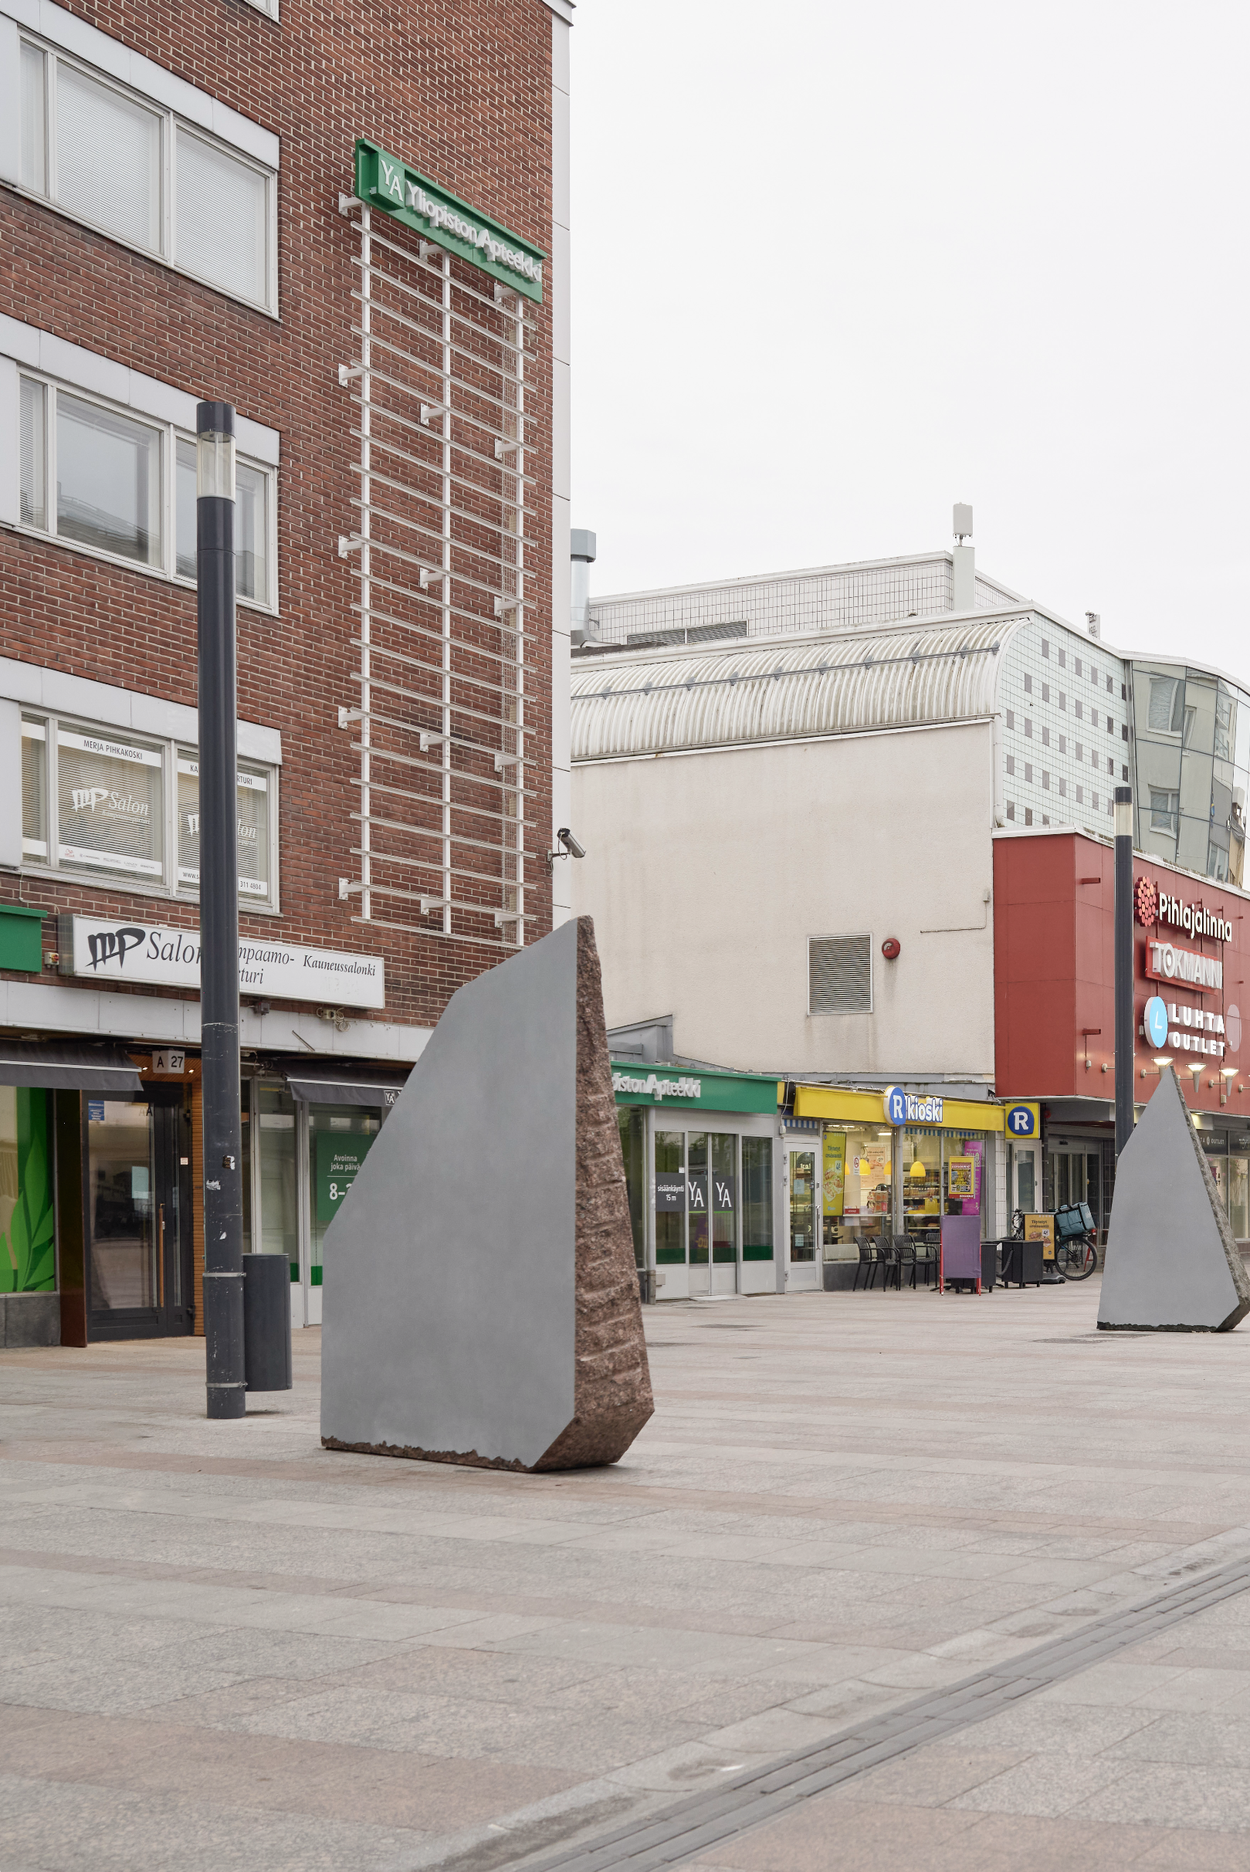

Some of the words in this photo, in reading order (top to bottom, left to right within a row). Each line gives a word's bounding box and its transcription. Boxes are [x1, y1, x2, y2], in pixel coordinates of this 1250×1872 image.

[380, 159, 404, 202] YA
[405, 179, 477, 244] Yliopiston
[475, 229, 542, 283] Apteekki
[84, 740, 104, 751] MERJA
[106, 744, 143, 760] PIHKAKOSKI
[237, 774, 253, 785] RTURI
[108, 792, 148, 815] Salon
[237, 818, 256, 838] lon
[1159, 892, 1232, 942] Pihlajalinna
[238, 946, 295, 965] mpaamo-
[303, 954, 376, 976] Kauneussalonki
[1150, 941, 1223, 990] TOKMANNI
[238, 967, 264, 984] turi
[1167, 1003, 1225, 1034] LUHTA
[1168, 1031, 1225, 1056] OUTLET
[157, 1056, 164, 1068] A
[171, 1056, 184, 1068] 27
[645, 1074, 701, 1101] Apteekki
[906, 1095, 944, 1123] kioski
[1014, 1112, 1029, 1130] R
[330, 1163, 344, 1172] joka
[333, 1154, 358, 1162] Avoinna
[657, 1184, 685, 1194] sisäänkäynti
[688, 1181, 705, 1208] YA
[715, 1182, 732, 1208] YA
